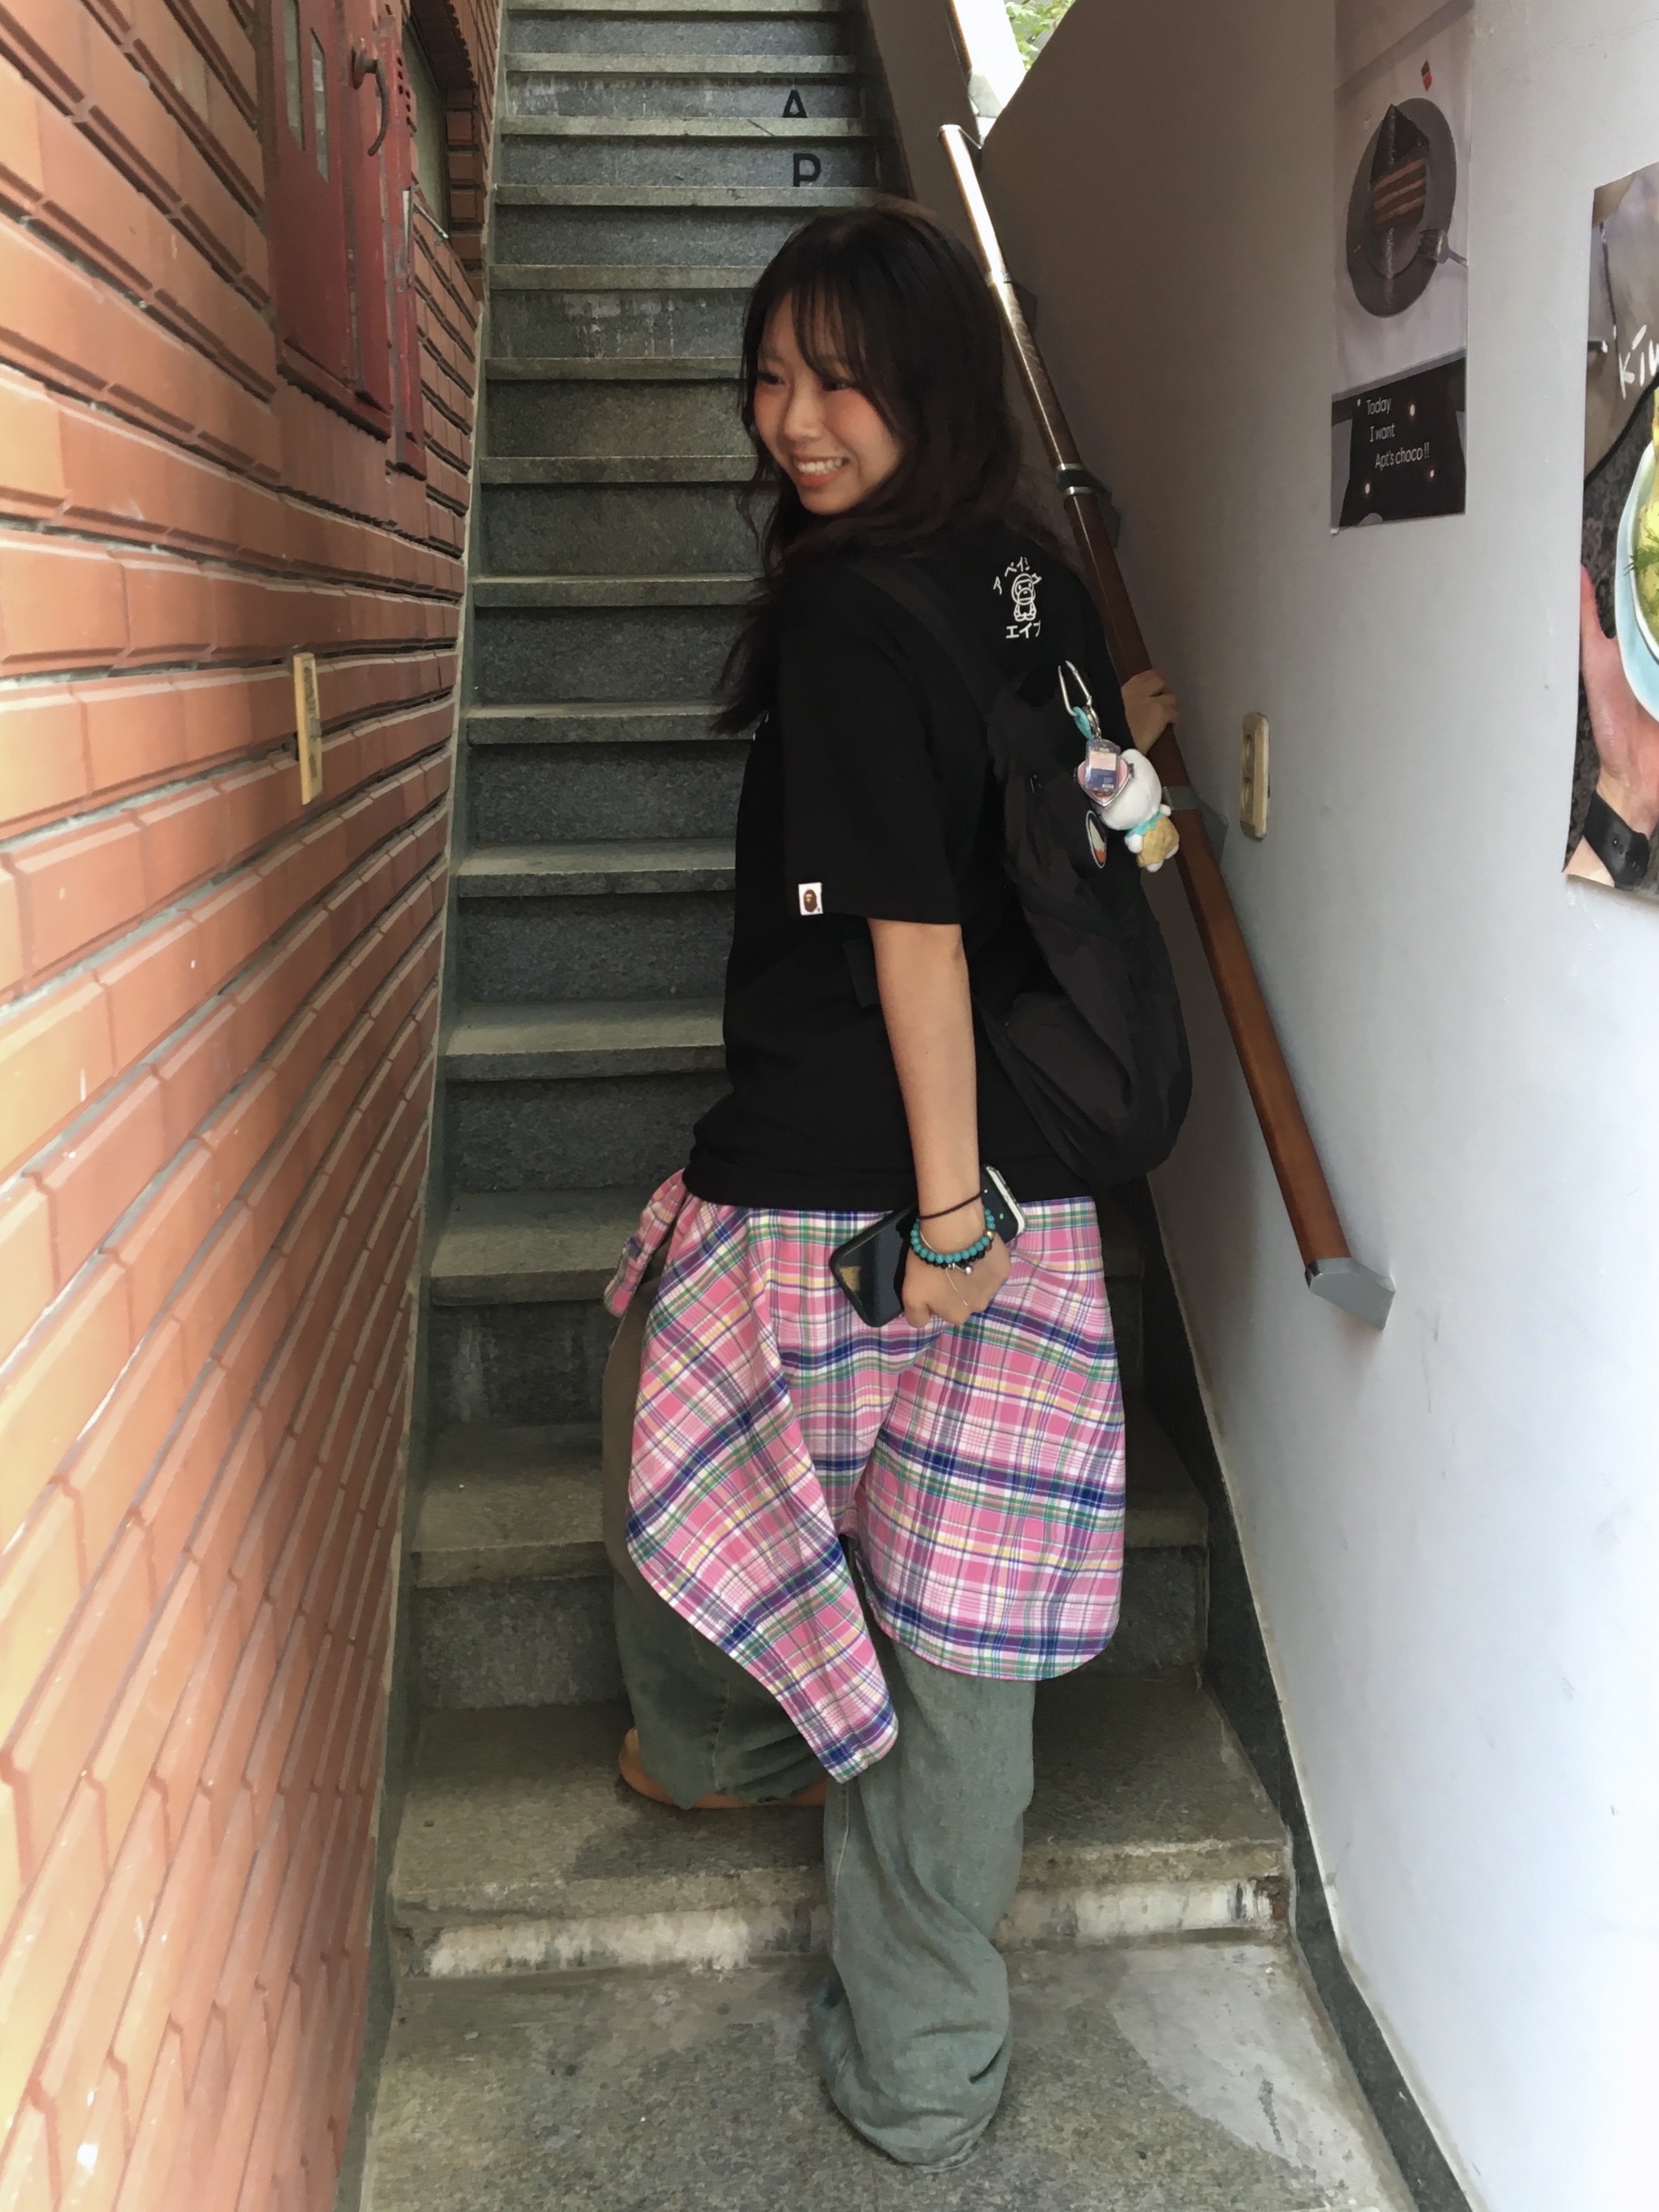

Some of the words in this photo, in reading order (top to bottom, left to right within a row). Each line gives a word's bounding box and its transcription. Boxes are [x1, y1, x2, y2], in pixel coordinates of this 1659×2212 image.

[1366, 397, 1392, 415] Today
[1369, 425, 1374, 443] I
[1375, 423, 1395, 440] want
[1375, 450, 1395, 471] Apt's
